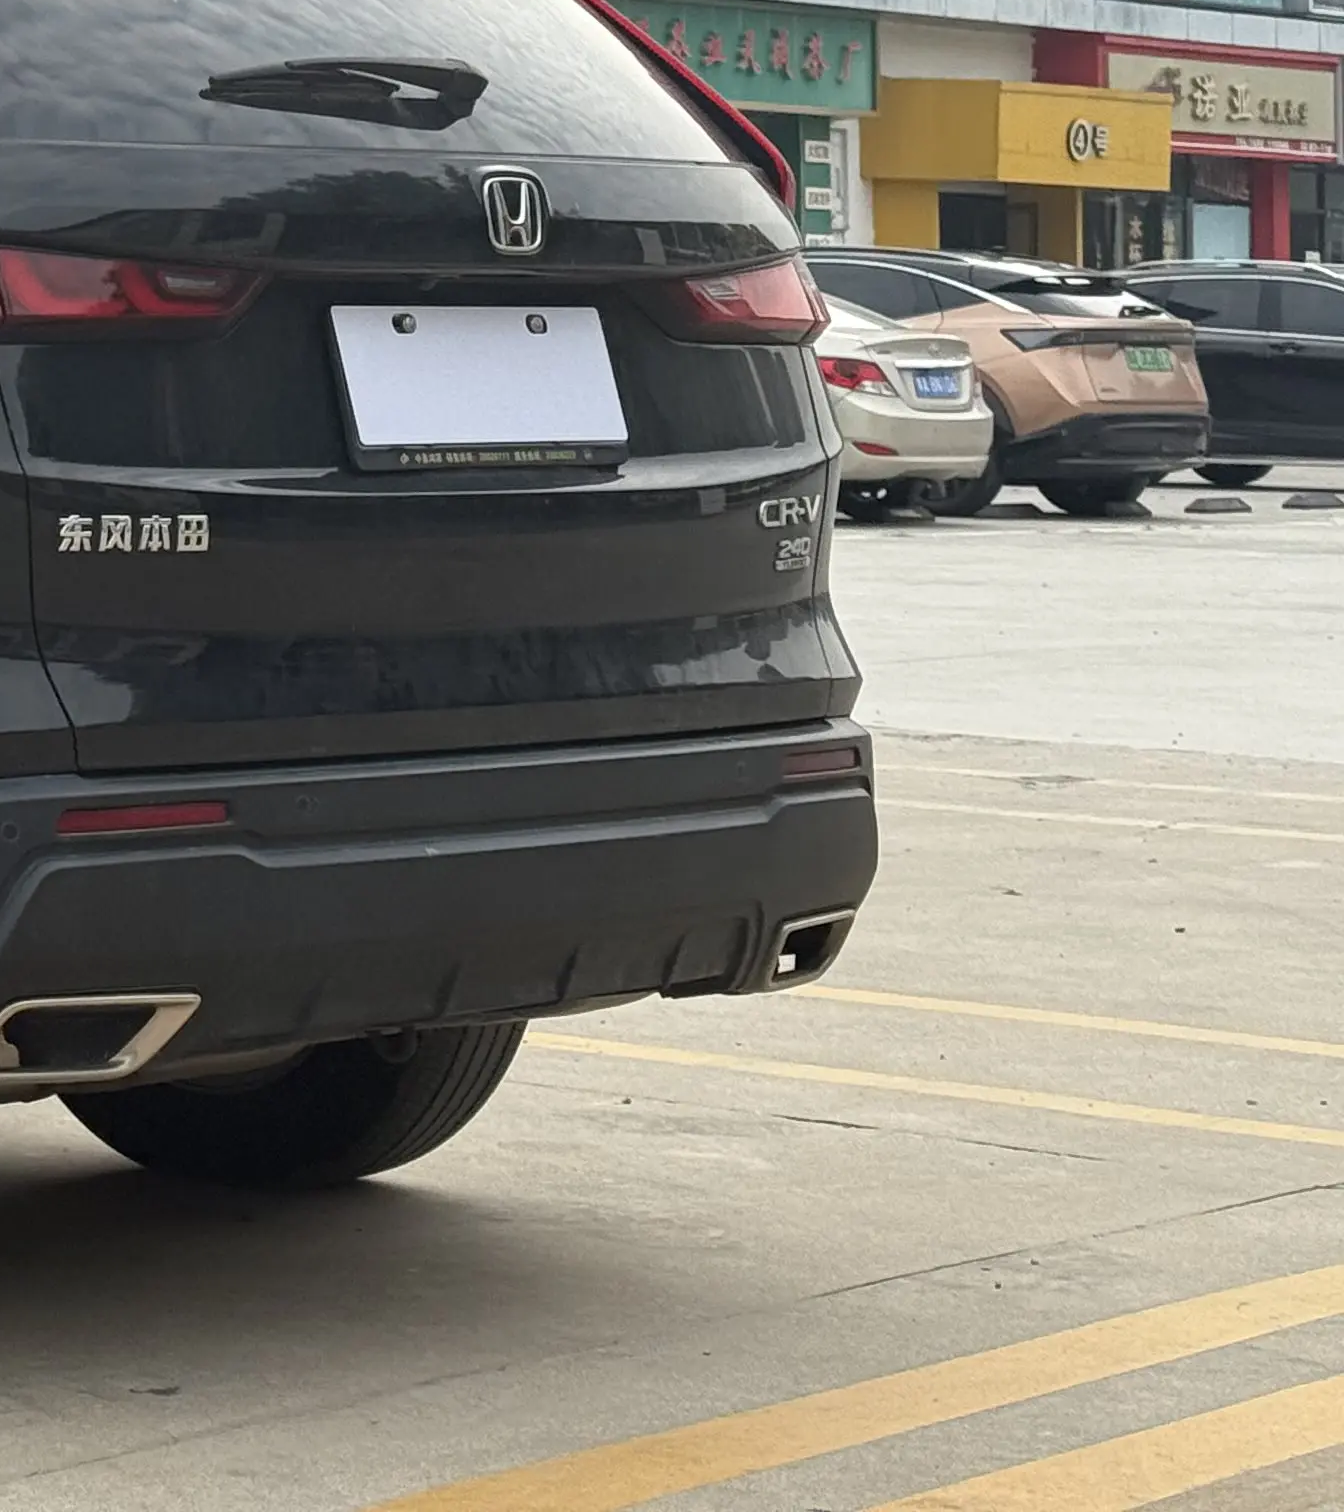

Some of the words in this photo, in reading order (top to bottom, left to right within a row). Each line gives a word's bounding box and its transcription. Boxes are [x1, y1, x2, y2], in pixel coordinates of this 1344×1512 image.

[759, 494, 820, 527] CR-V
[58, 515, 210, 552] 东风本田
